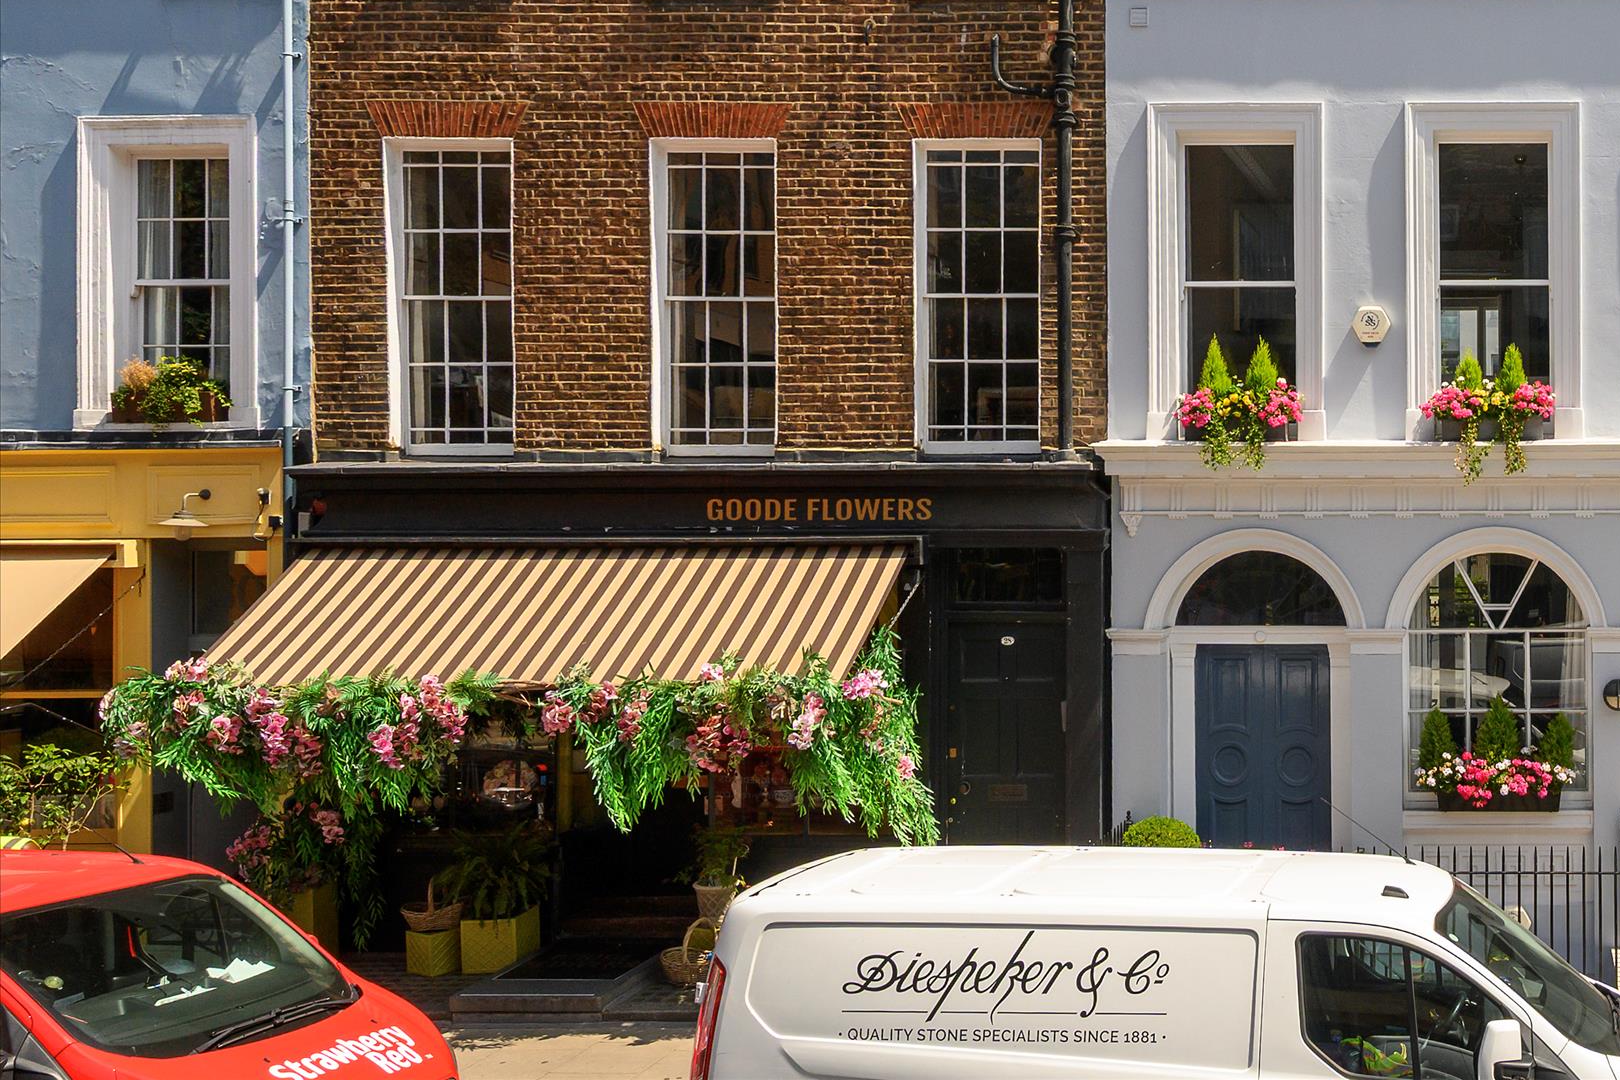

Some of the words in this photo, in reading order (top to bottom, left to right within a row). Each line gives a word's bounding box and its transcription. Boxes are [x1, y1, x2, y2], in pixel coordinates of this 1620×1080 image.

[706, 498, 798, 521] GOODE
[806, 498, 933, 521] FLOWERS
[842, 930, 1073, 1025] Diespeker
[1076, 946, 1113, 1018] &
[847, 1027, 913, 1041] QUALITY
[917, 1028, 968, 1041] STONE
[972, 1029, 1069, 1043] SPECIALISTS
[1073, 1031, 1119, 1043] SINCE
[1123, 1032, 1158, 1044] 1881
[269, 1026, 415, 1080] Strawberry
[364, 1042, 423, 1074] Red
